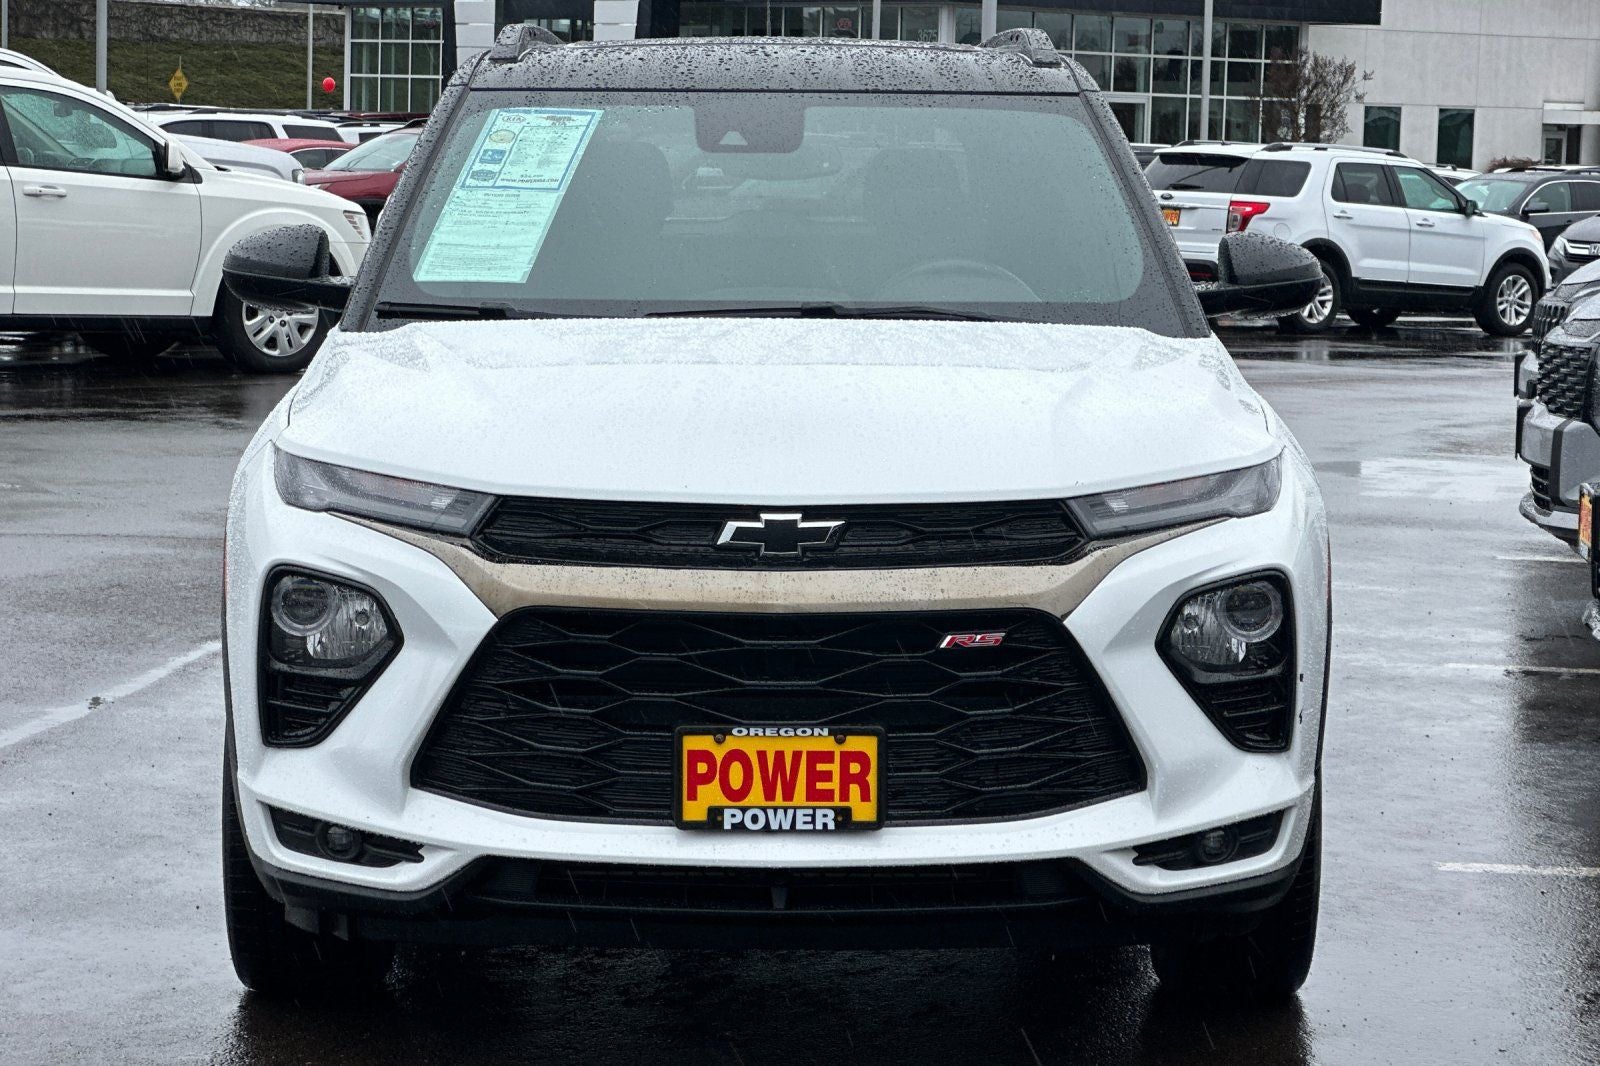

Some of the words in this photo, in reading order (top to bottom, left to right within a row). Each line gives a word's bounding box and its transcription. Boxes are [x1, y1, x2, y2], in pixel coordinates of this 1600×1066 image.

[940, 632, 1006, 649] RS
[731, 727, 829, 737] OREGON
[686, 748, 872, 803] POWER
[723, 808, 836, 830] POWER
